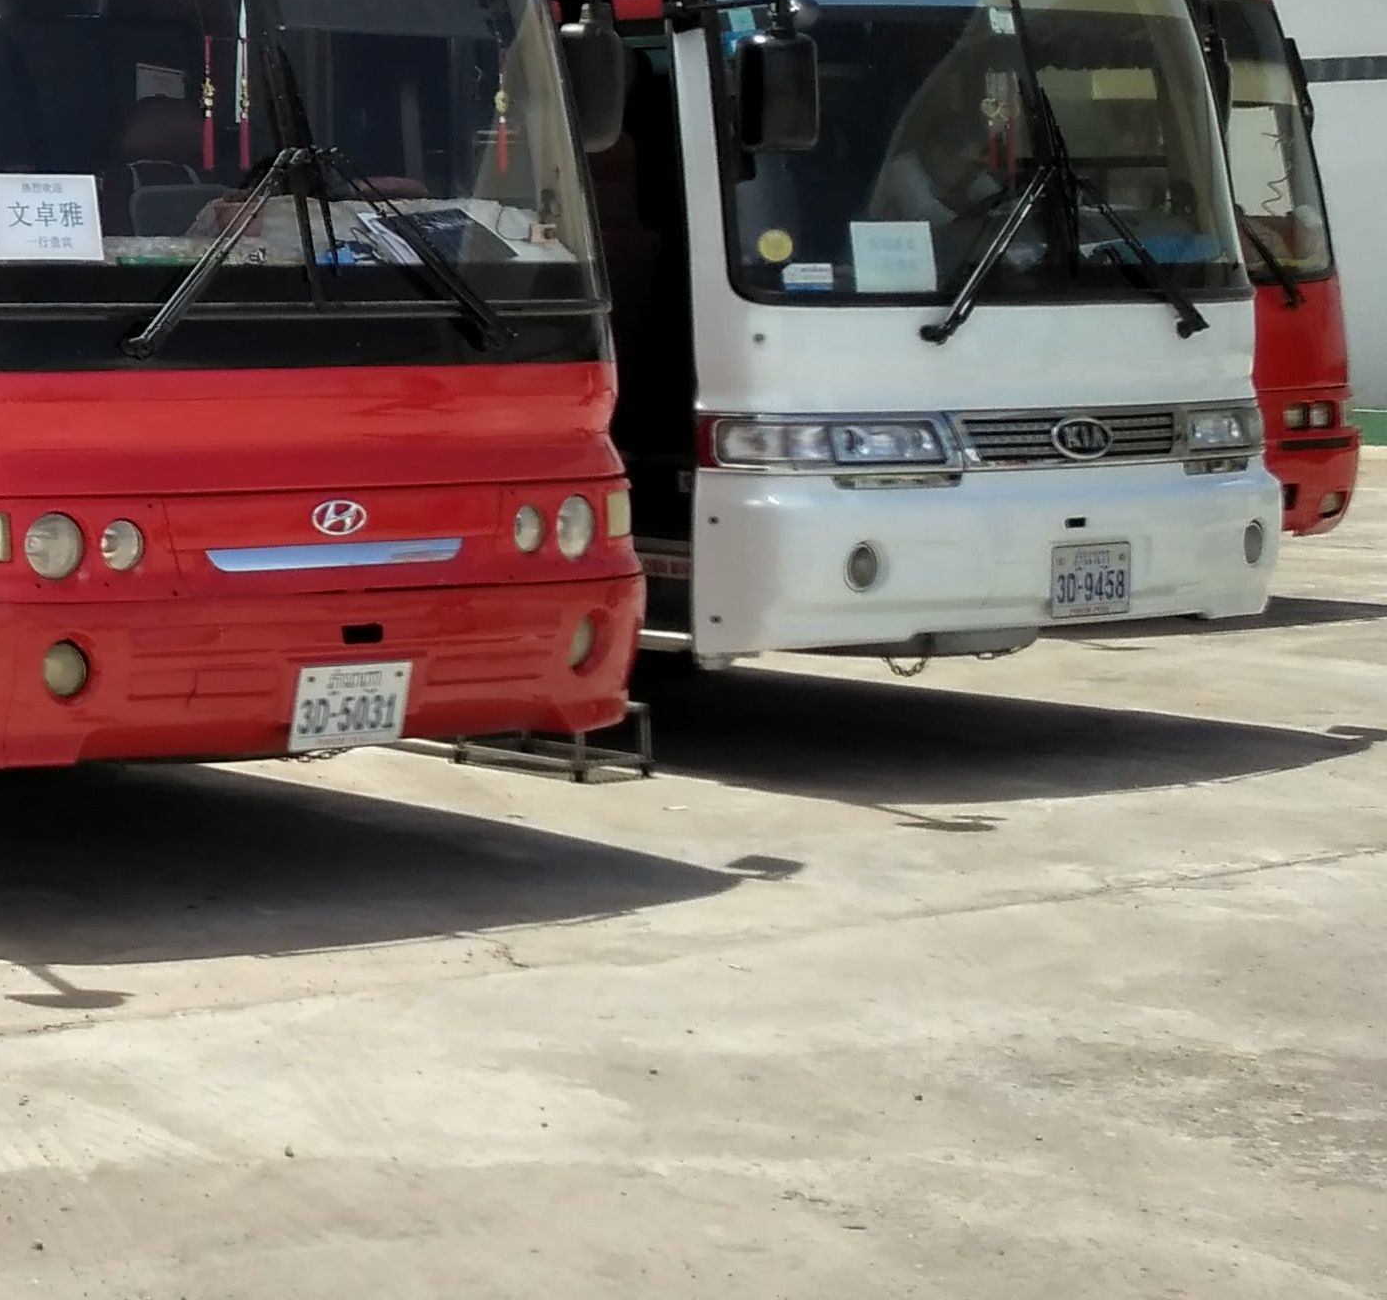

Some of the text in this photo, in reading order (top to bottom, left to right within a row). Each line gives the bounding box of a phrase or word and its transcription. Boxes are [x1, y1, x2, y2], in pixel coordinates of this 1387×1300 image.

[7, 201, 84, 228] 文卓雅
[1063, 425, 1106, 448] KIA
[1056, 570, 1126, 604] 3D-9458
